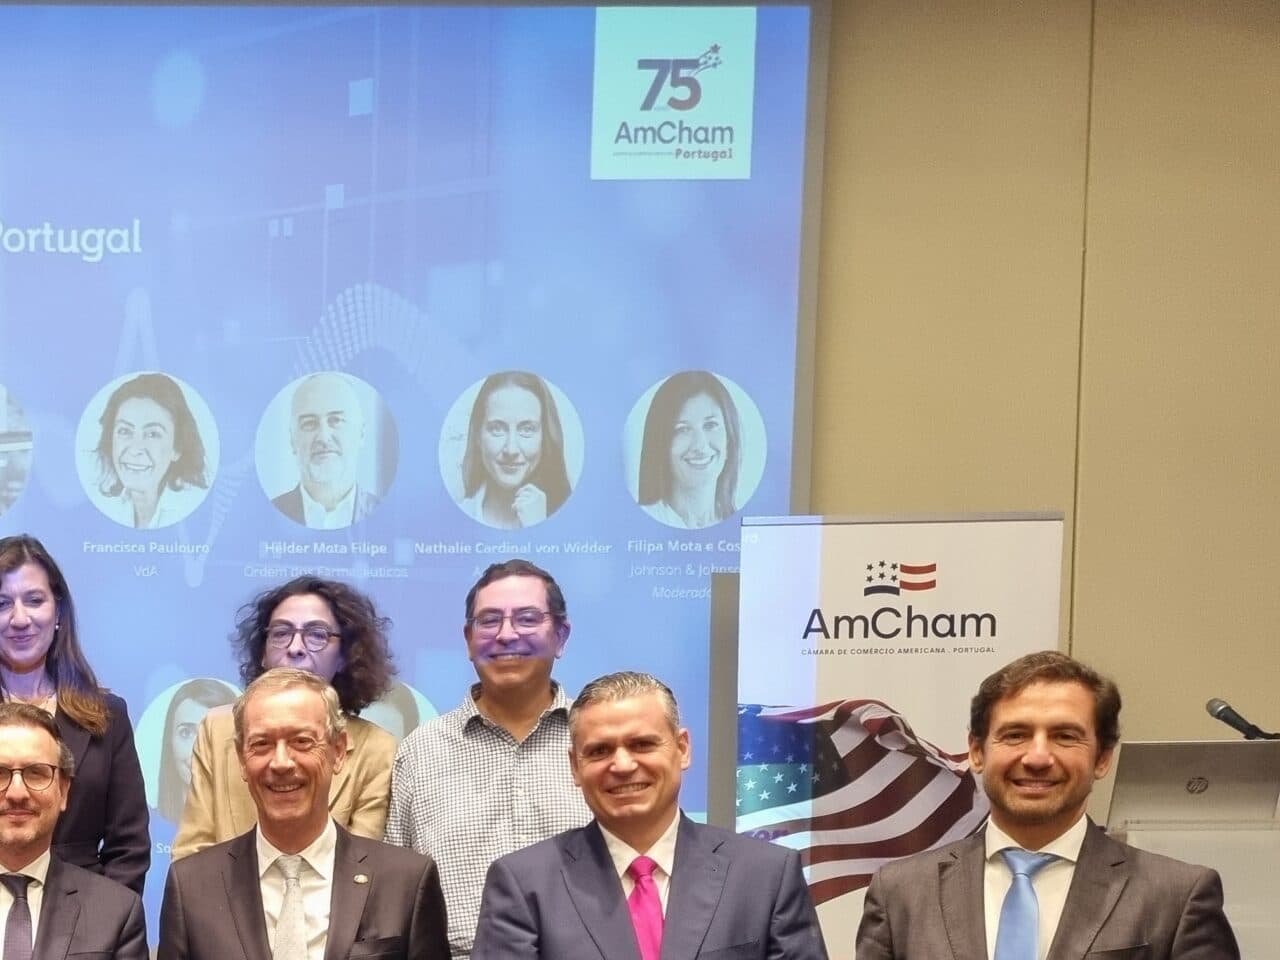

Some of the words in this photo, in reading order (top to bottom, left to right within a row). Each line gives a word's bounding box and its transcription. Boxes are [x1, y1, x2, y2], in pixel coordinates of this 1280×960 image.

[637, 58, 702, 111] 75
[614, 120, 734, 144] AmCham
[675, 148, 733, 162] Portugal
[83, 541, 146, 554] Francisca
[149, 541, 210, 554] Paulouro
[313, 541, 347, 554] Mota
[351, 541, 388, 557] Filipe
[414, 542, 472, 554] Nathalie
[475, 541, 531, 554] Cardinal
[535, 544, 560, 554] von
[564, 542, 613, 554] Widder
[627, 539, 663, 555] Filipa
[667, 540, 703, 552] Mota
[133, 565, 160, 577] VdA
[628, 563, 682, 578] Johnson
[685, 563, 696, 576] &
[802, 605, 997, 639] AmCham
